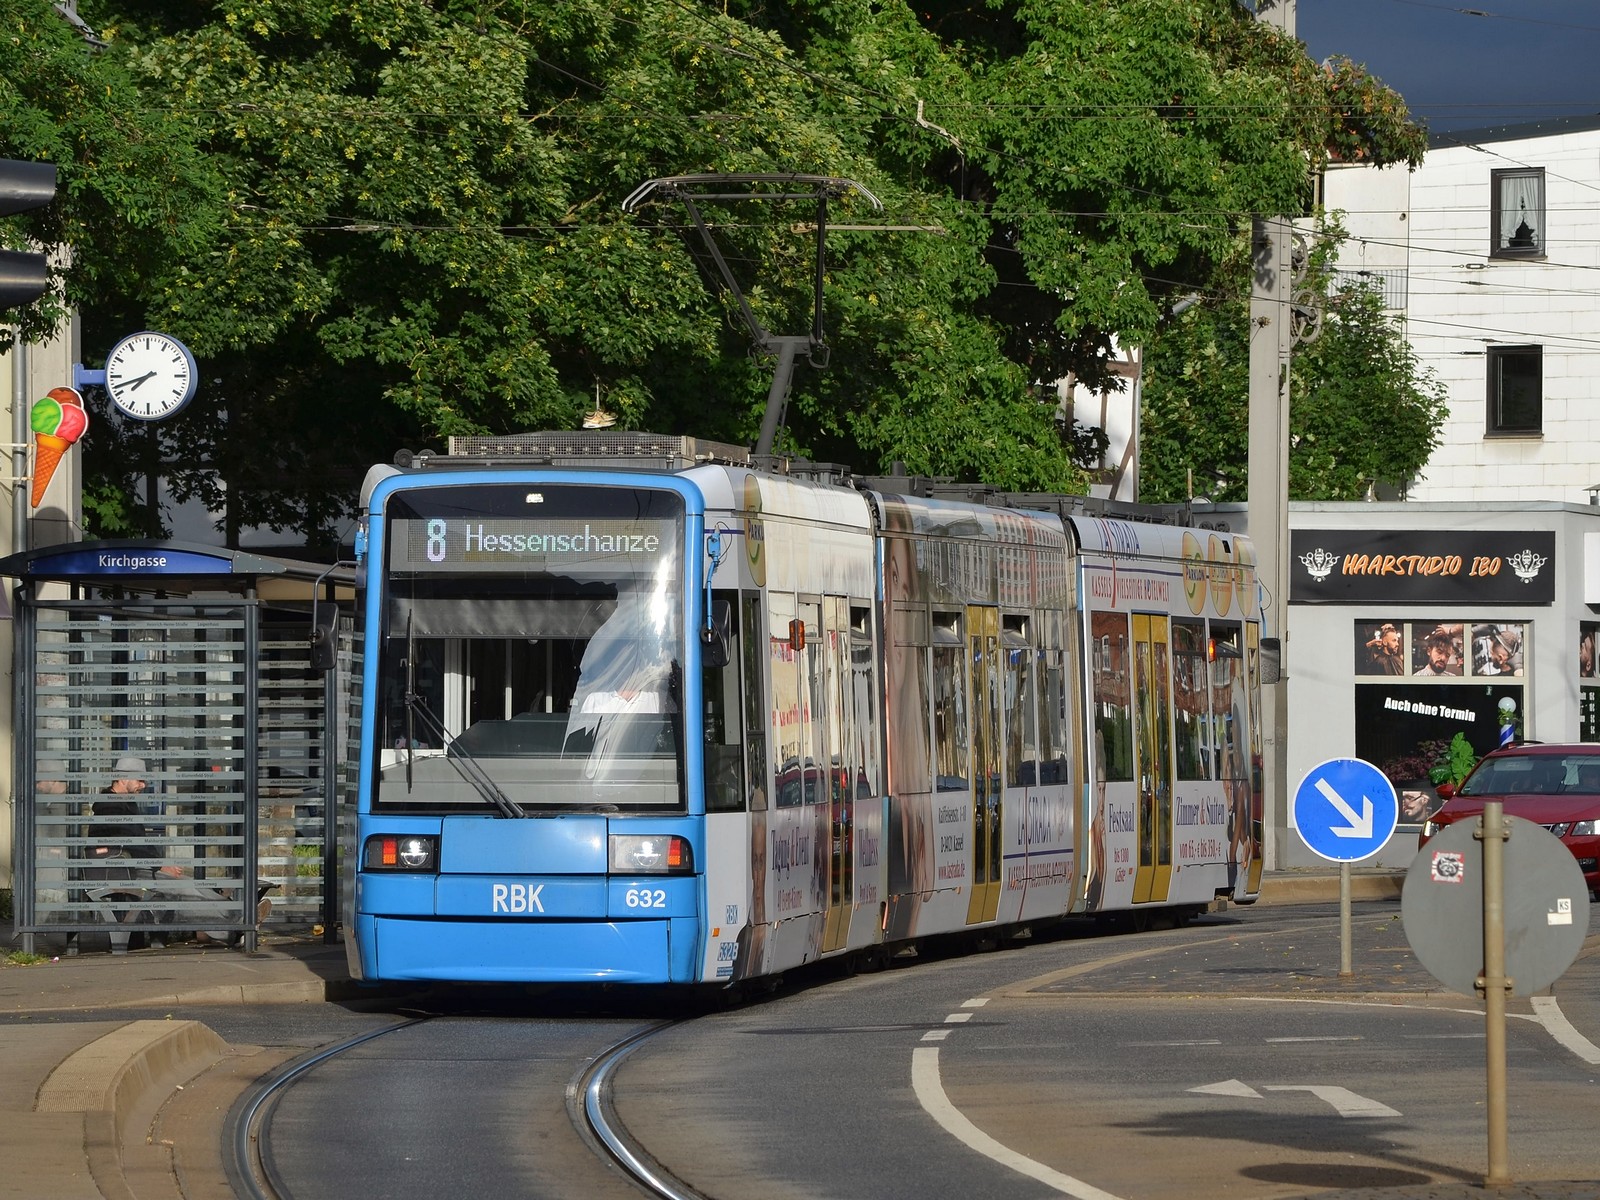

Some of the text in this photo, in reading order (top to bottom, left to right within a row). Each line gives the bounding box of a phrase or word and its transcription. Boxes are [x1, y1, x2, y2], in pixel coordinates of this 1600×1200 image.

[427, 518, 660, 562] 8 Hessenschanze
[98, 555, 167, 570] Kirchgasse
[1342, 553, 1502, 577] HAARSTUDIO IBO
[1384, 697, 1476, 722] Auch ohne Termin
[1108, 803, 1135, 833] Festsaal
[1176, 795, 1225, 826] Zimmer & Suiten
[492, 884, 545, 913] RBK
[625, 889, 666, 908] 632
[1559, 901, 1569, 911] KS
[717, 942, 739, 960] 632B
